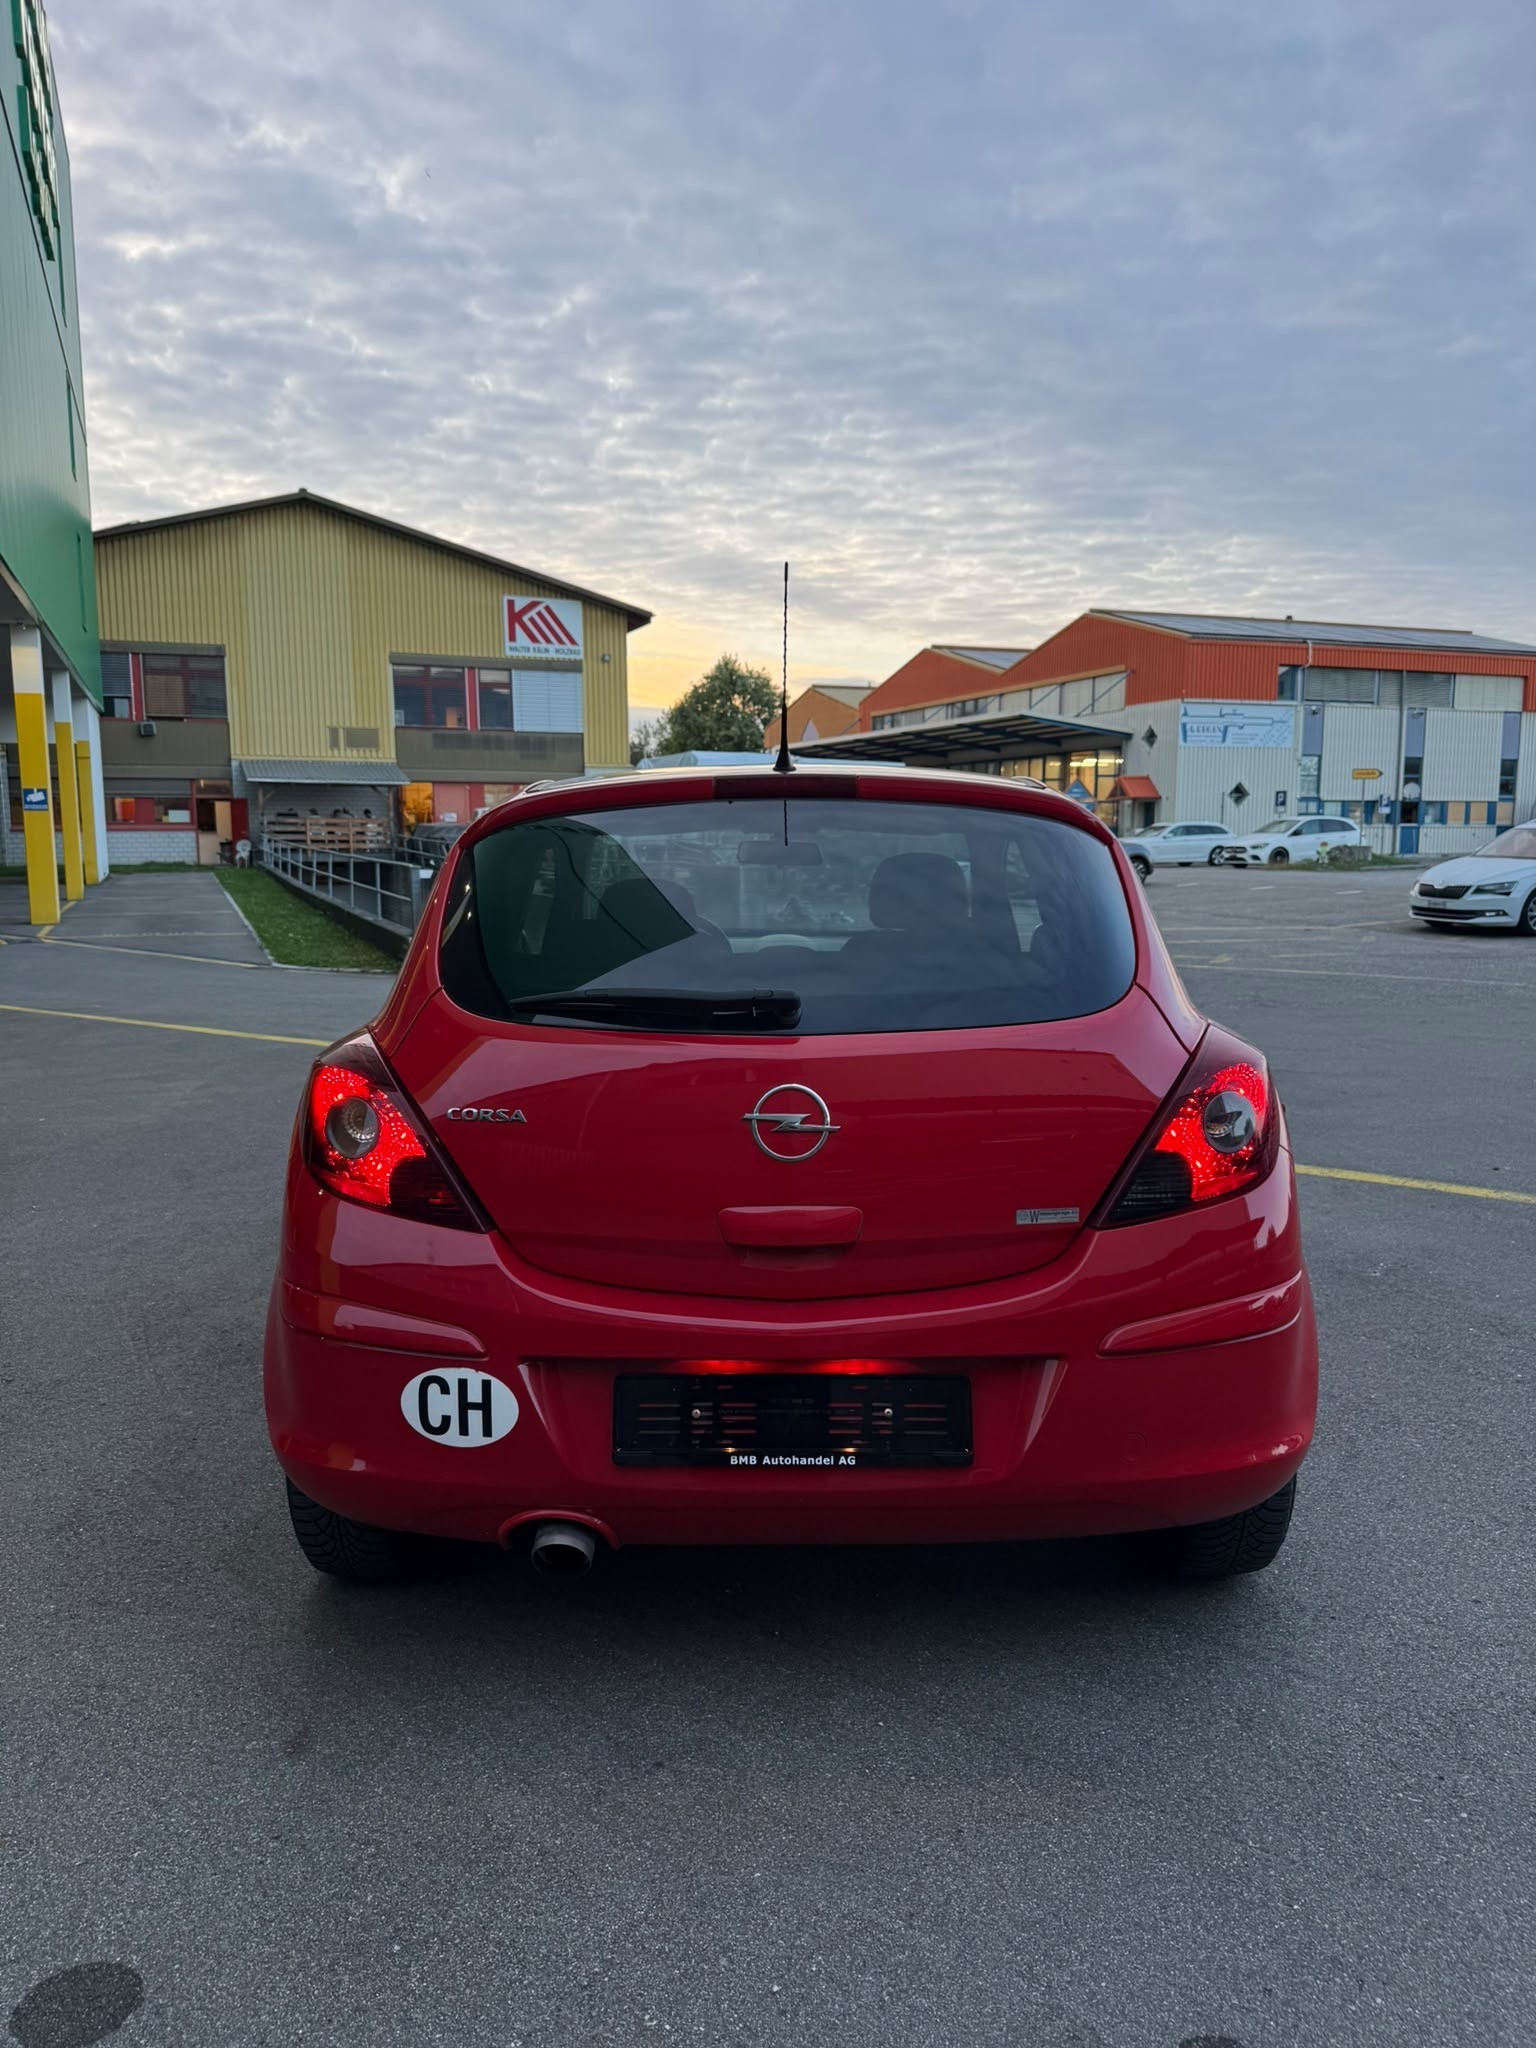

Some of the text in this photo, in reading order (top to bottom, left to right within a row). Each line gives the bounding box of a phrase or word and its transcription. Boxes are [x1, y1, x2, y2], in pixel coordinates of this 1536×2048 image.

[447, 1107, 527, 1123] CORSA
[418, 1375, 493, 1438] CH
[730, 1455, 856, 1465] BMB Autohandel AG
